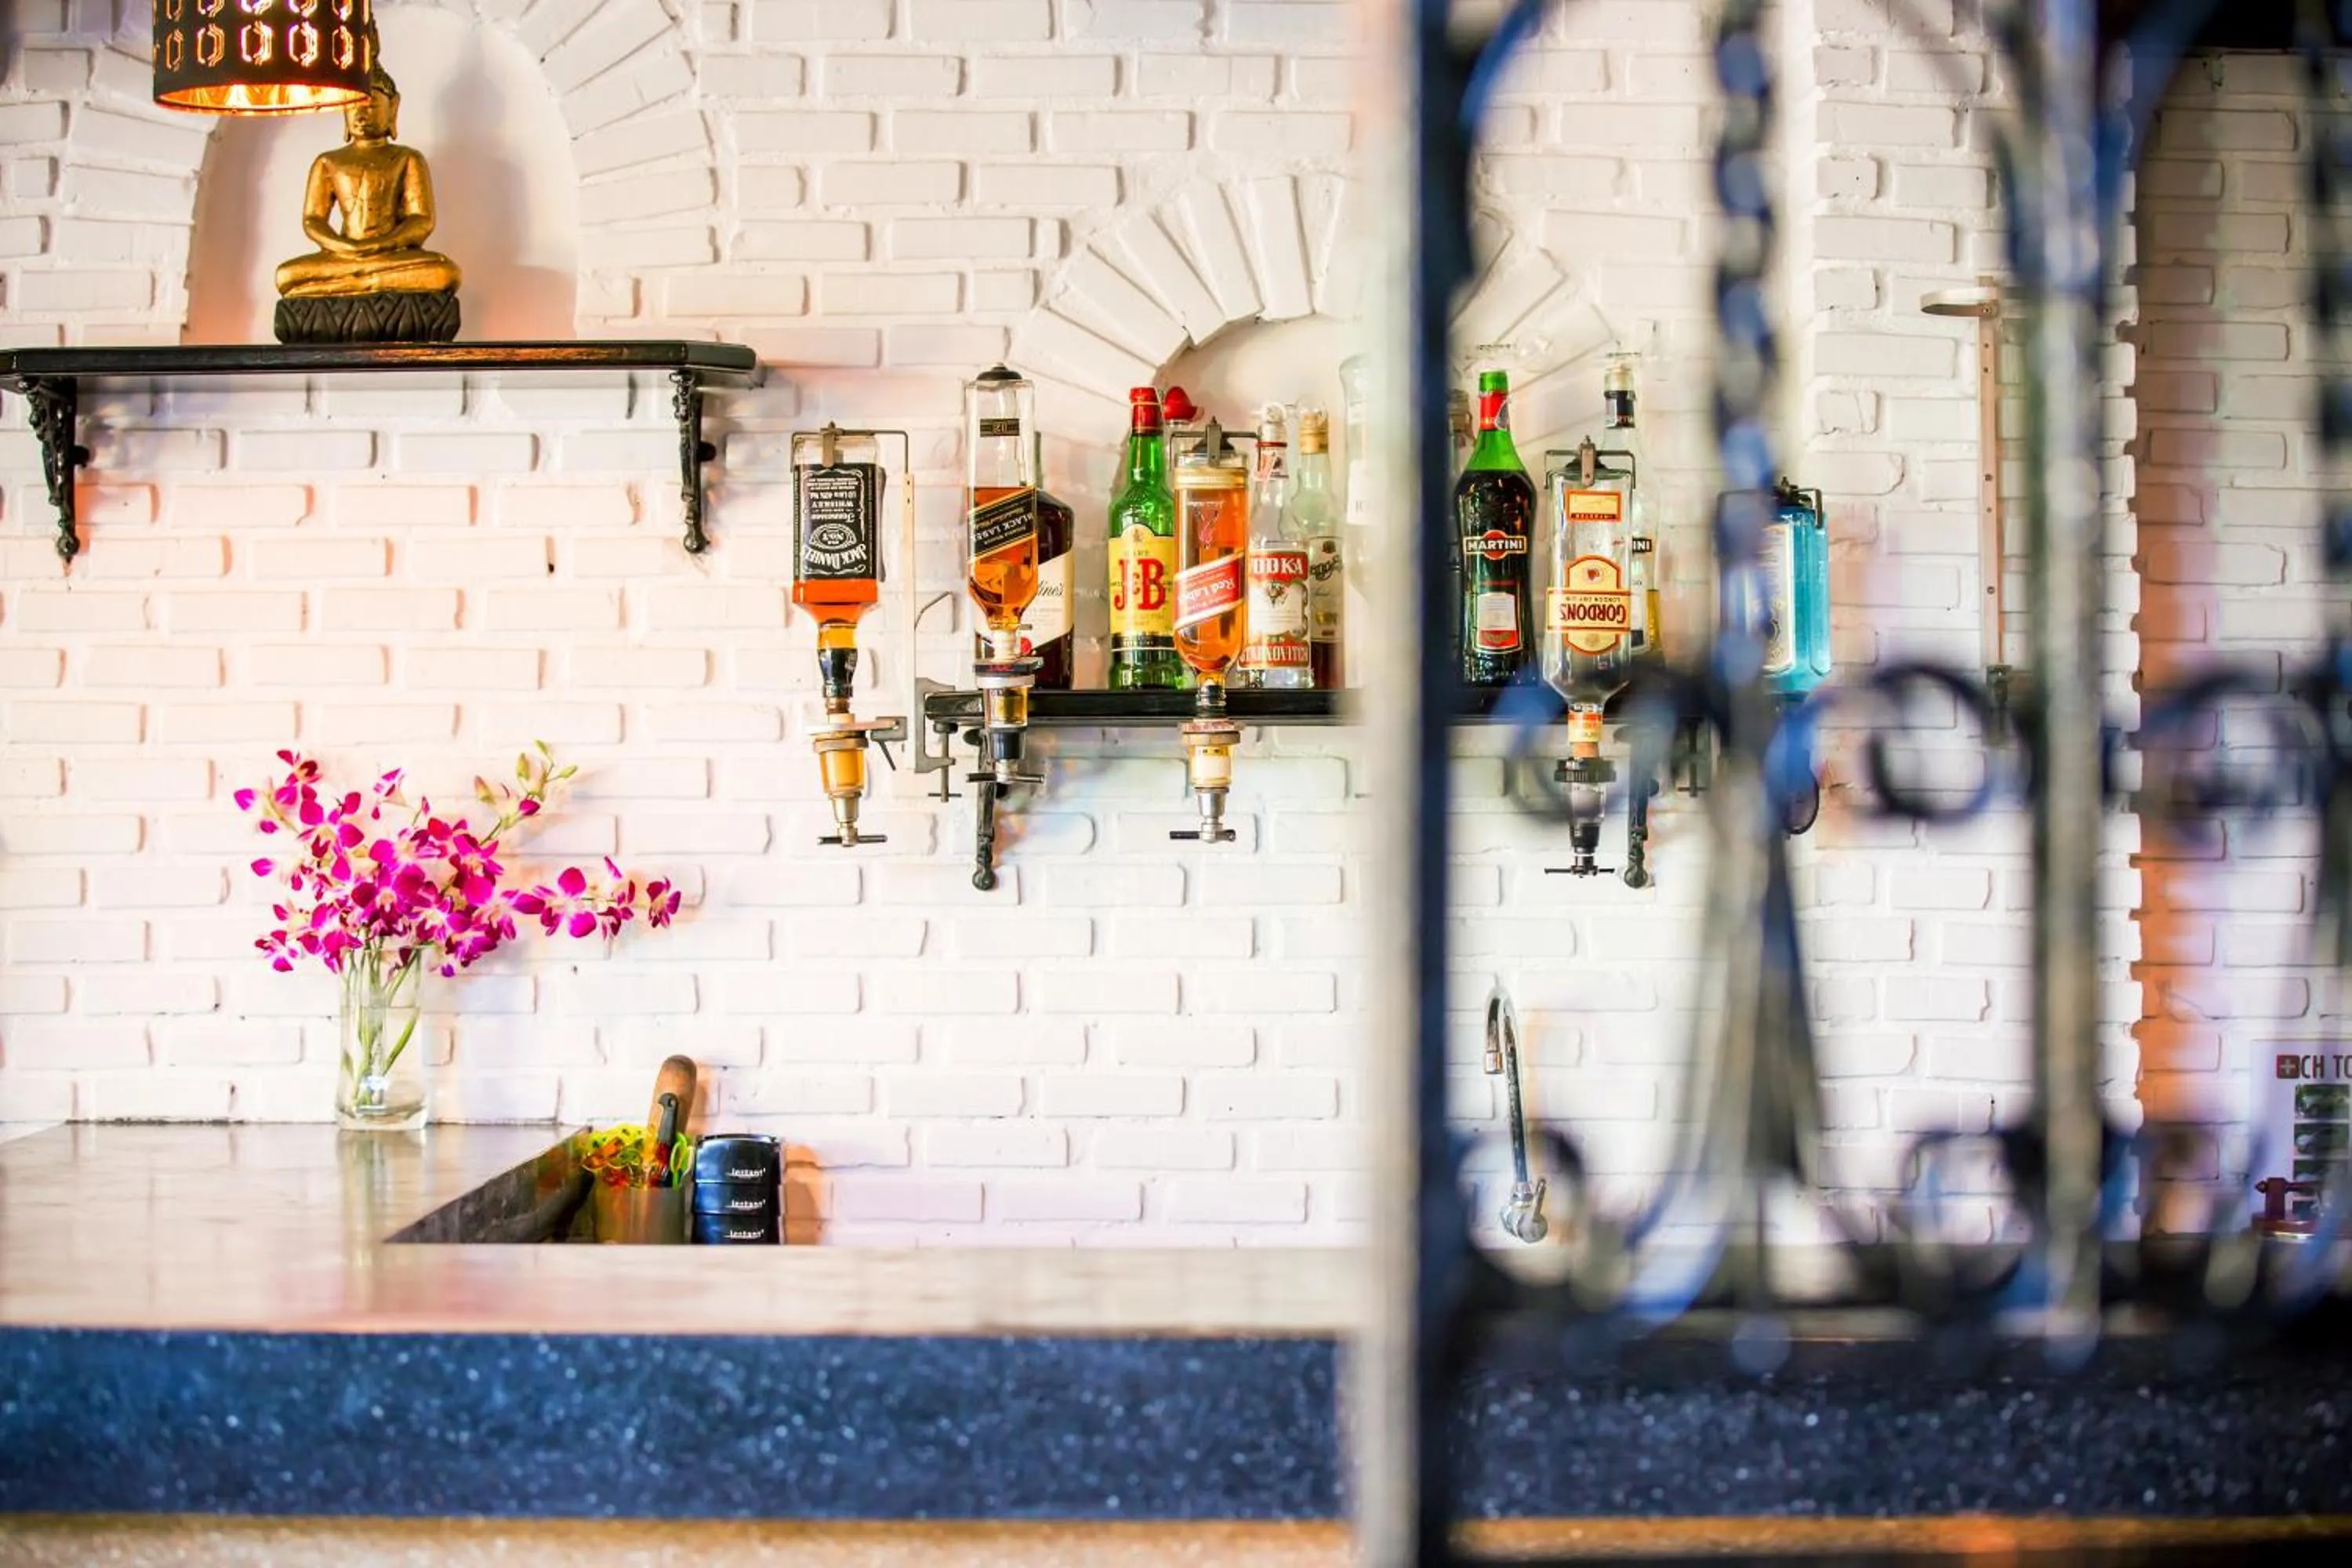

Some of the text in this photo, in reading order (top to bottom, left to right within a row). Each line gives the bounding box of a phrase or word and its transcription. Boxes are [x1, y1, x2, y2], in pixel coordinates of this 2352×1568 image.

[1003, 513, 1034, 531] BLACK
[1468, 539, 1523, 550] MARTINI
[1633, 540, 1650, 550] INI
[840, 544, 868, 566] JACK
[1253, 557, 1304, 575] ODKA
